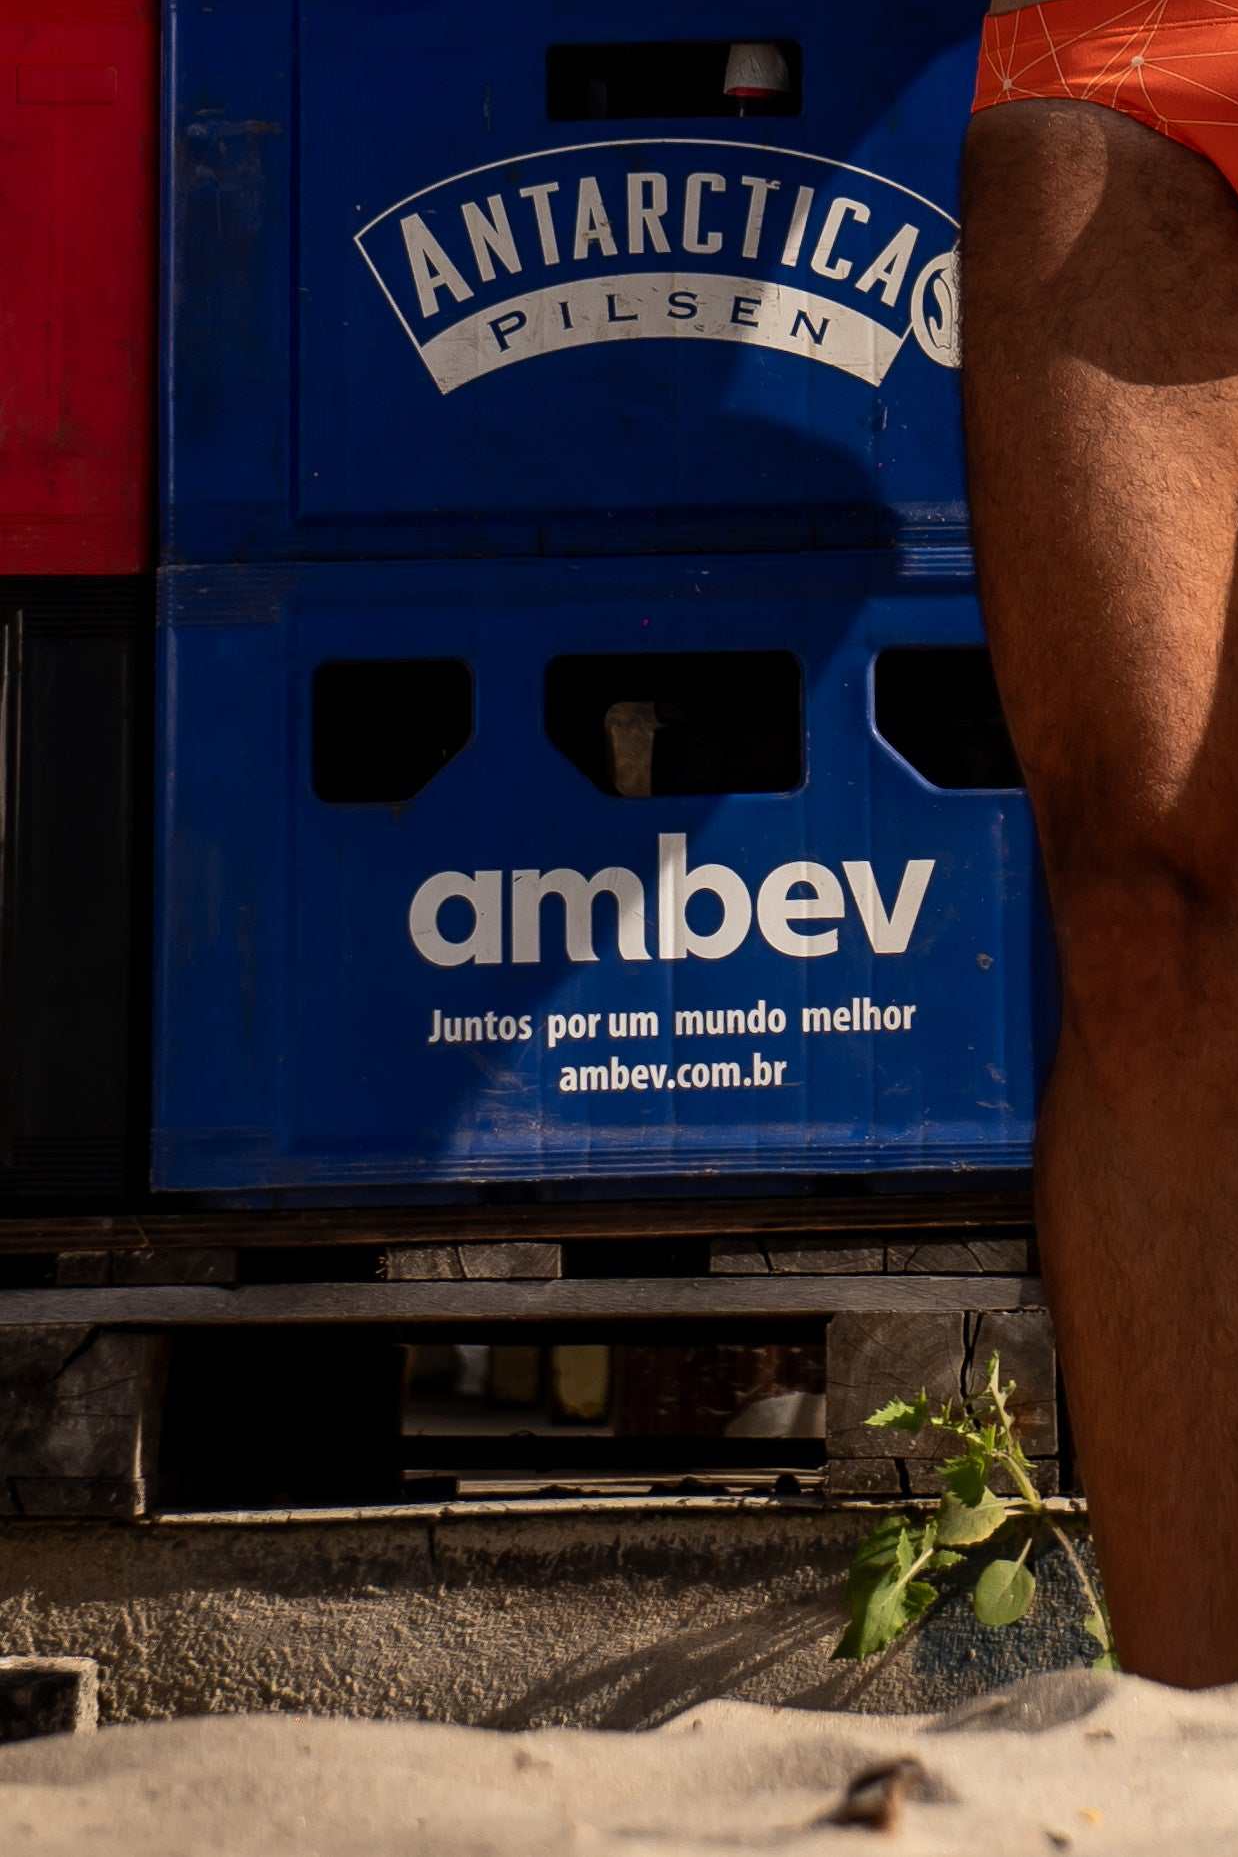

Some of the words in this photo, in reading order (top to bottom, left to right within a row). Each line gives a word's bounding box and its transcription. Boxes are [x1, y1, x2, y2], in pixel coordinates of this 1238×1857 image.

[400, 171, 921, 319] ANTARCTICA
[484, 291, 833, 352] PILSEN
[408, 832, 937, 967] ambev
[427, 1009, 533, 1044] Juntos
[547, 1012, 602, 1049] por
[608, 1011, 660, 1038] um
[674, 999, 788, 1037] mundo
[801, 996, 918, 1034] melhor
[558, 1051, 789, 1093] ambev.com.br
